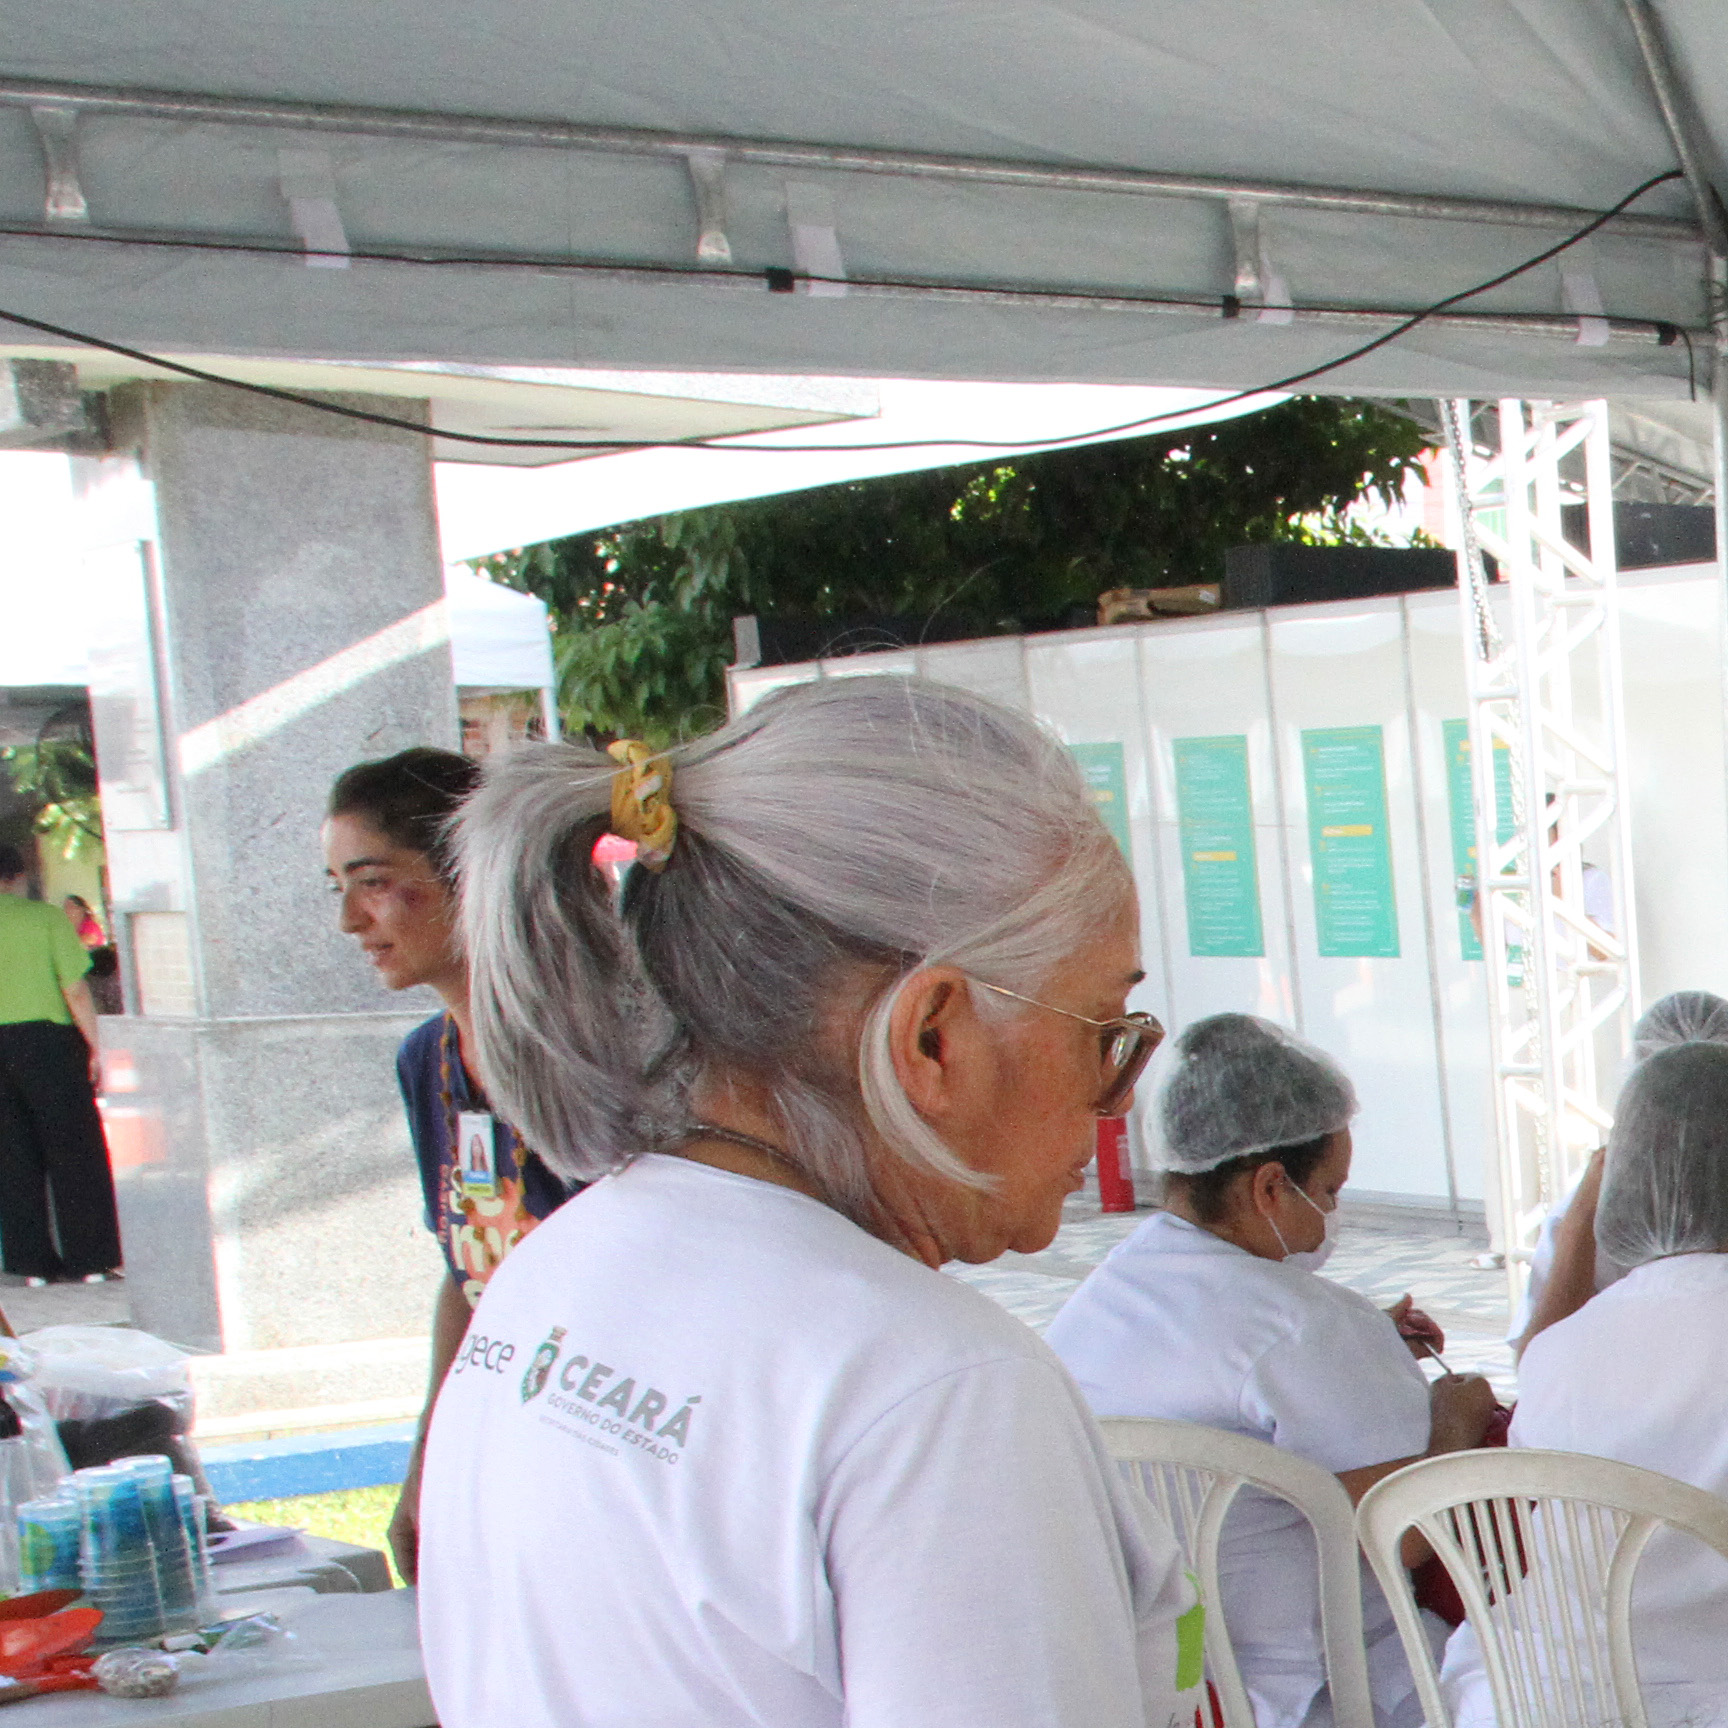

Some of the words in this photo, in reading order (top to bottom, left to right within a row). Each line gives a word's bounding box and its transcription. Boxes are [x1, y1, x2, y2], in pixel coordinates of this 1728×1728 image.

[547, 1393, 600, 1426] GOVERNO
[599, 1418, 622, 1436] DO
[621, 1428, 679, 1466] ESTADO
[560, 1354, 703, 1449] CEARÁ
